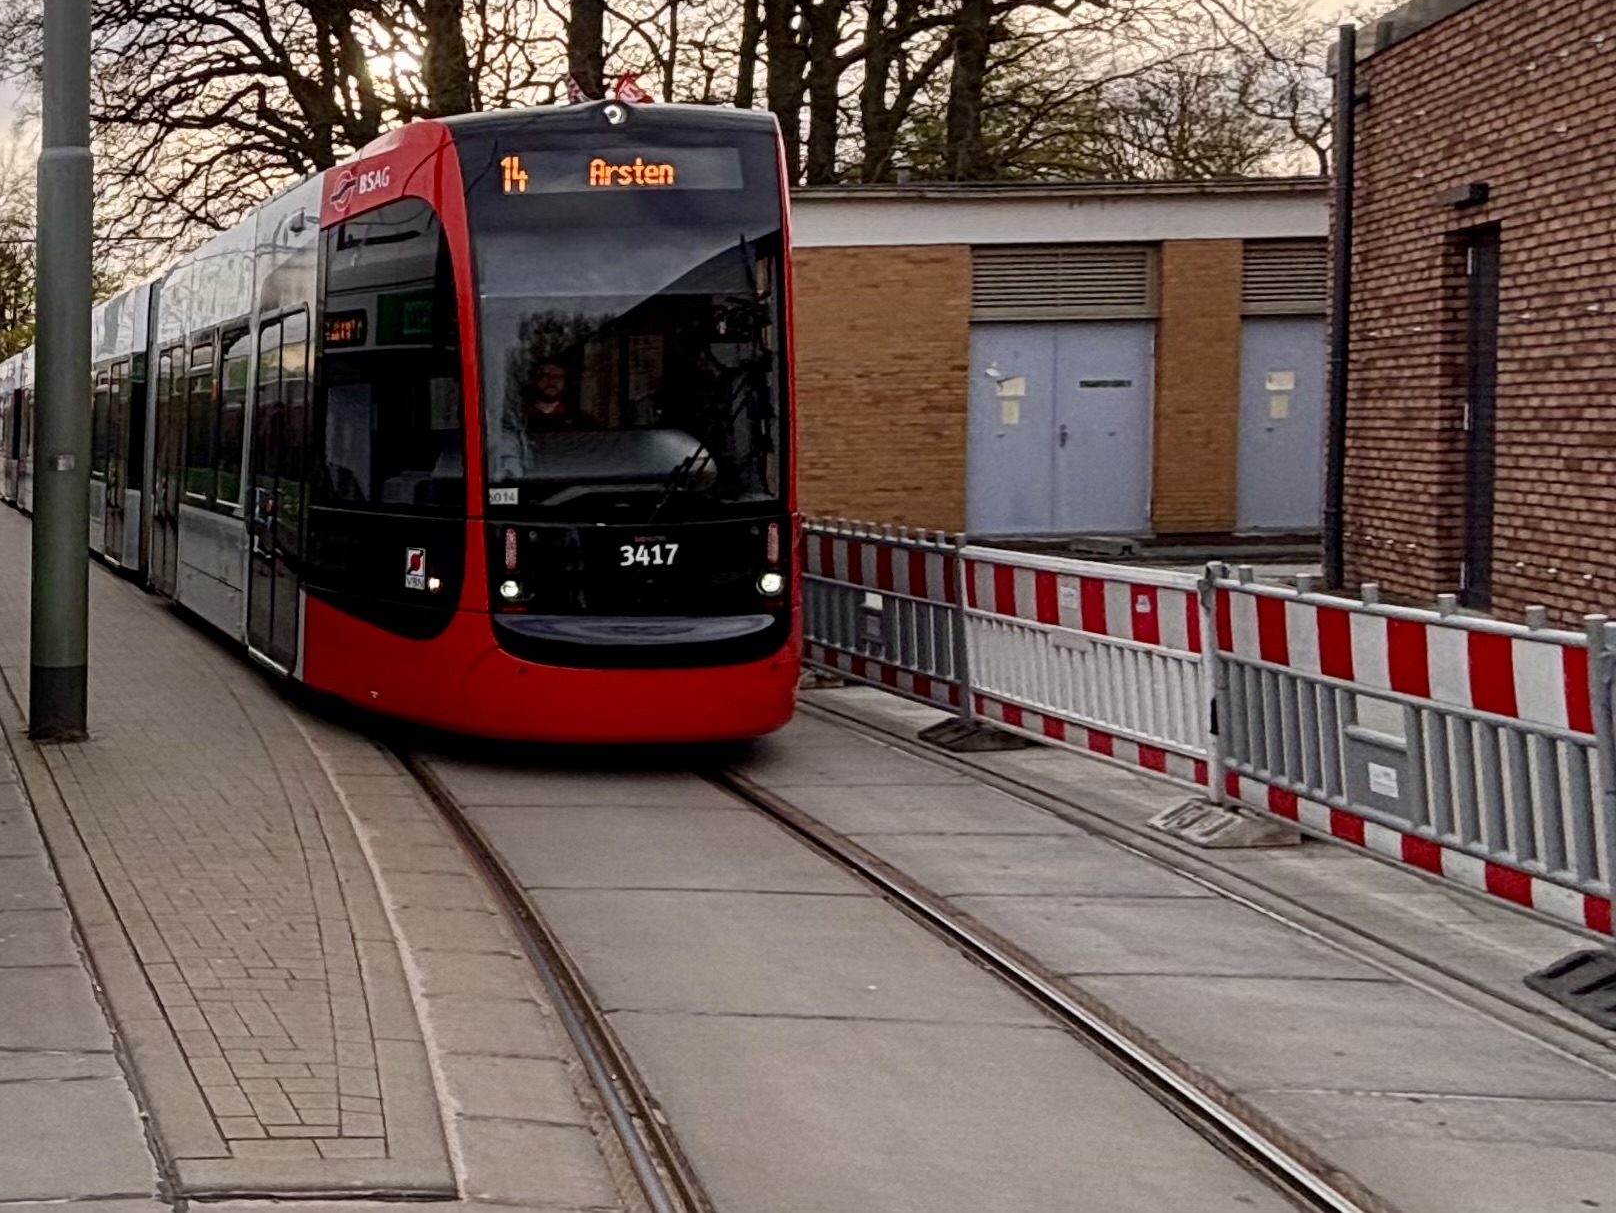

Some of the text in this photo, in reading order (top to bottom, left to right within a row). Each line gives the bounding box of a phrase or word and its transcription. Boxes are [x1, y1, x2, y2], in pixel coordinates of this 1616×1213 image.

[359, 166, 391, 194] BSAG
[500, 156, 675, 193] 14 Arsten
[620, 543, 679, 566] 3417
